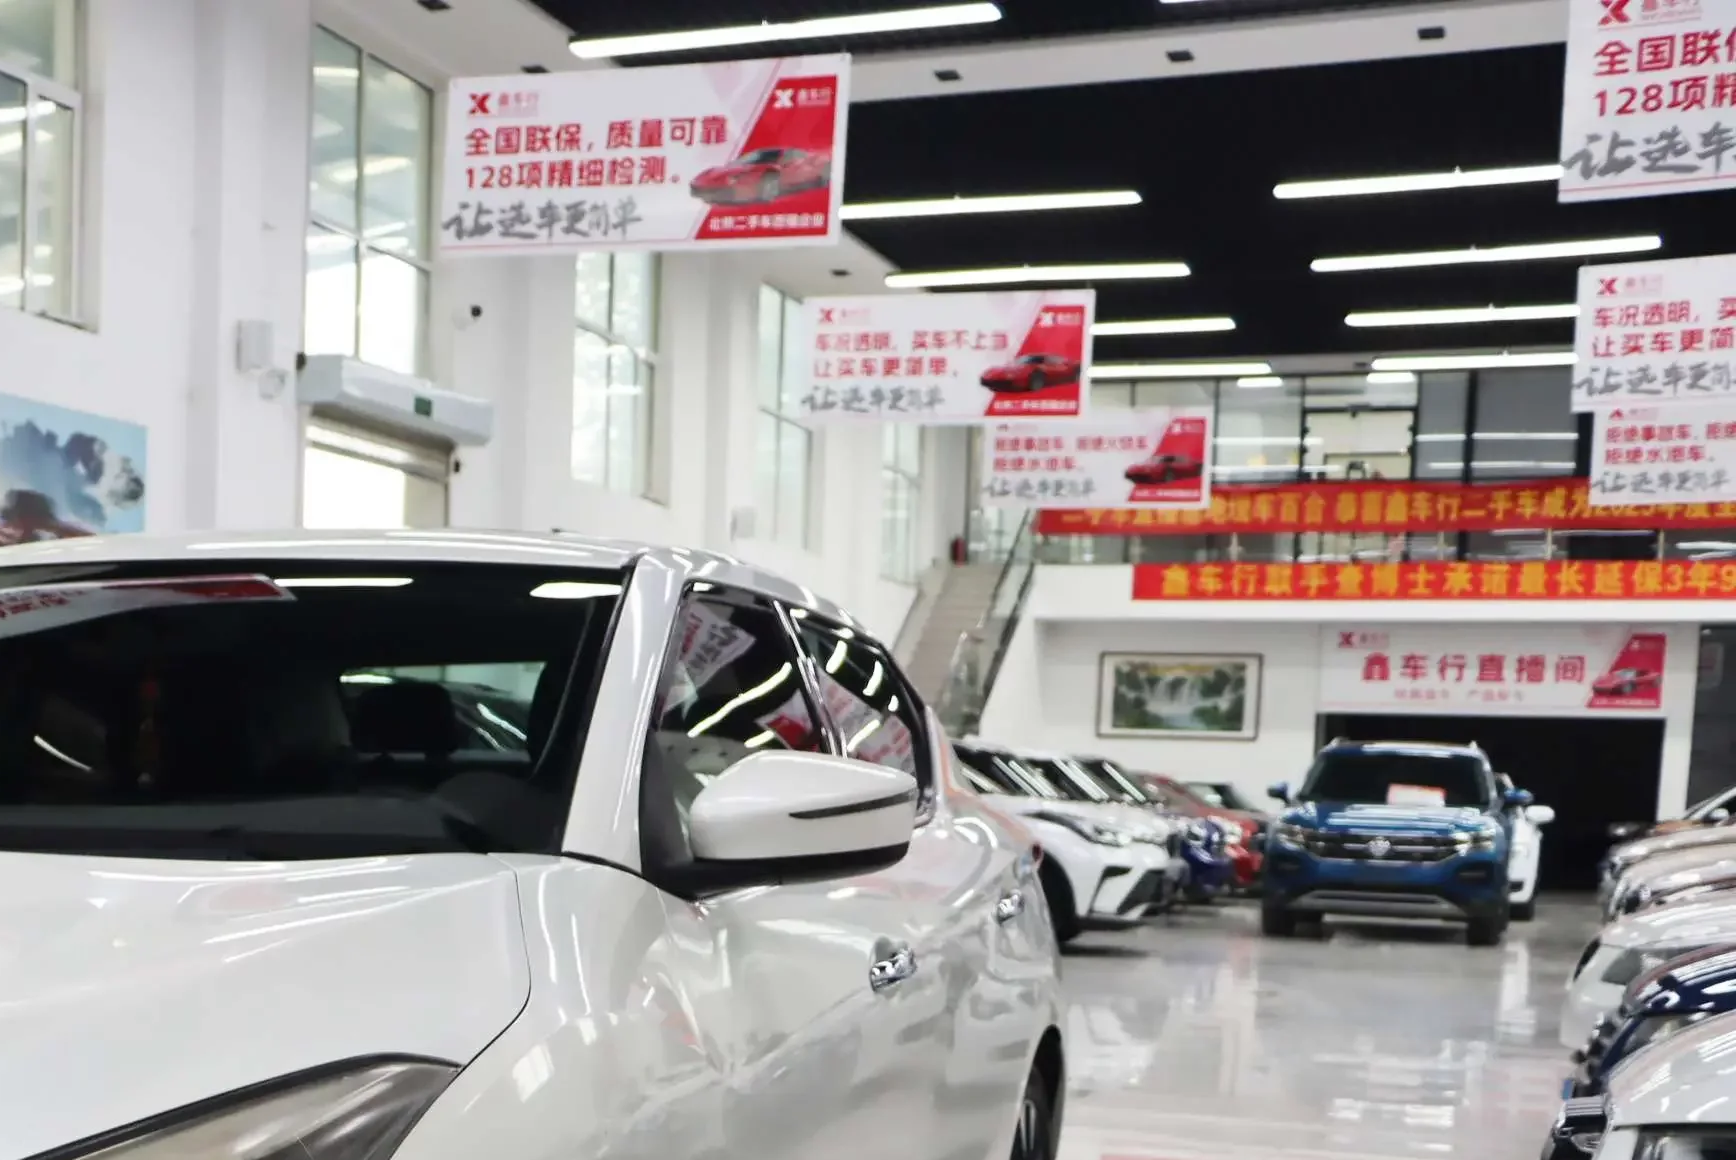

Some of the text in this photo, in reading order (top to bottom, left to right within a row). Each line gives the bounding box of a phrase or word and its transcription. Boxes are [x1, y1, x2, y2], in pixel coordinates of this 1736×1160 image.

[1560, 121, 1736, 181] 让选车
[1571, 360, 1736, 397] 让选车更简
